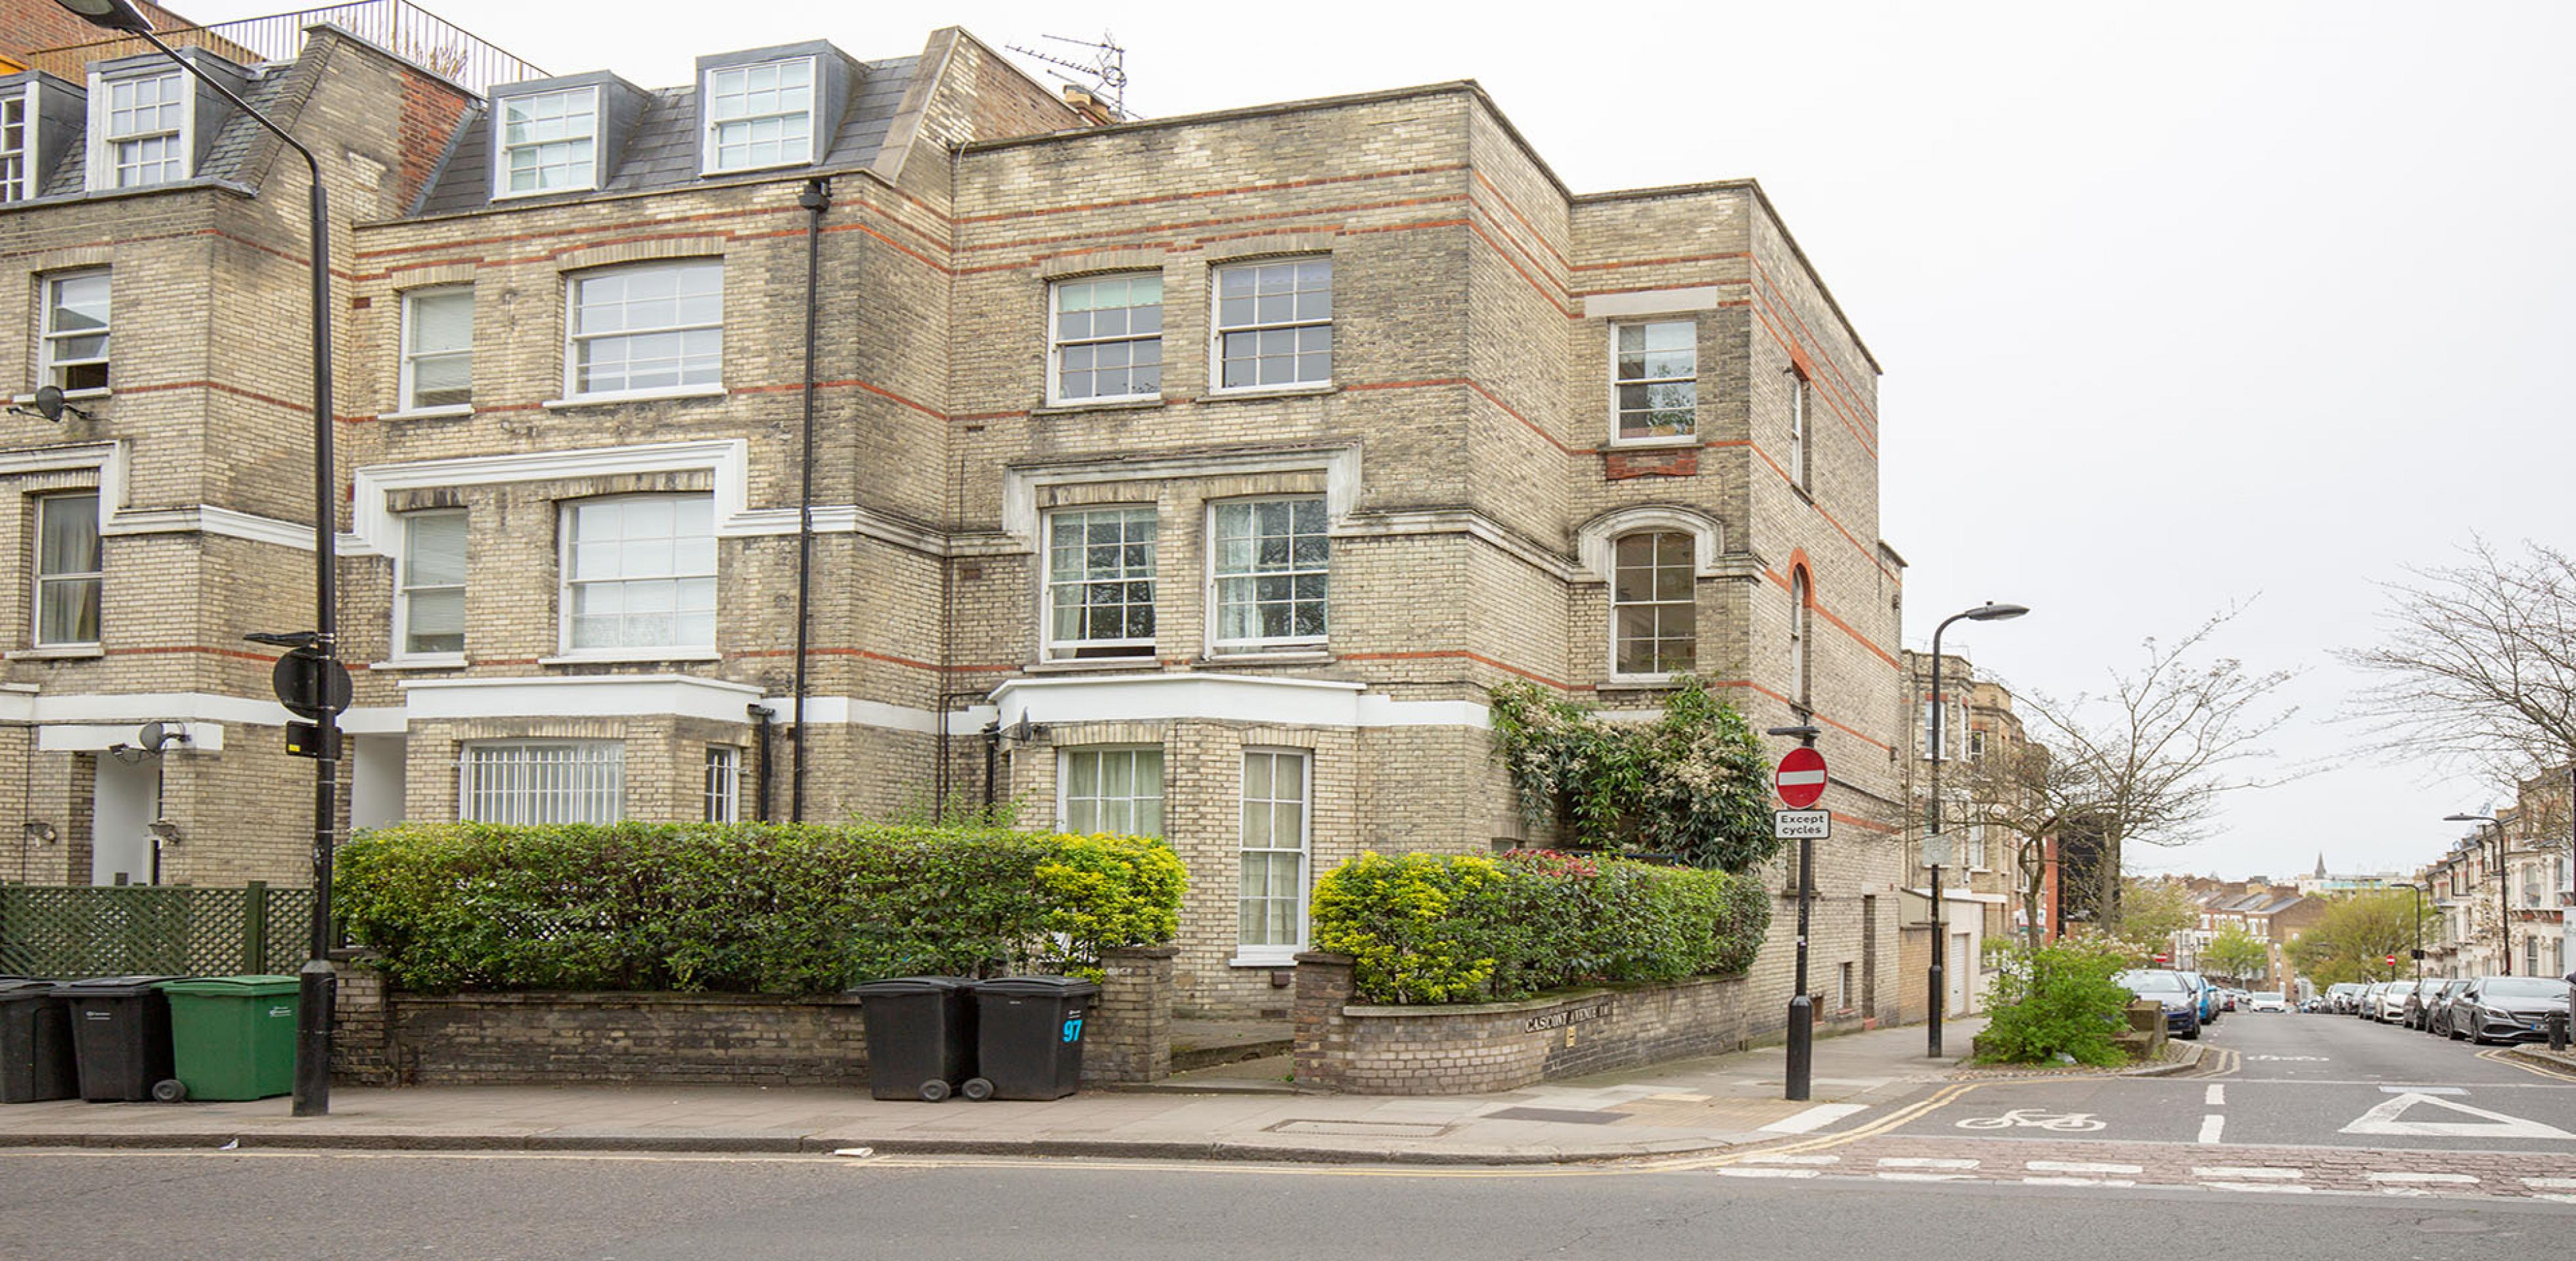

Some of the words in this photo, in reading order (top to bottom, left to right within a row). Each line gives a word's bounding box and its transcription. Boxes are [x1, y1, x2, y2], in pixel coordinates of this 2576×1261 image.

[1781, 815, 1824, 824] Except
[1782, 826, 1821, 836] cycles
[1062, 1019, 1083, 1042] 97
